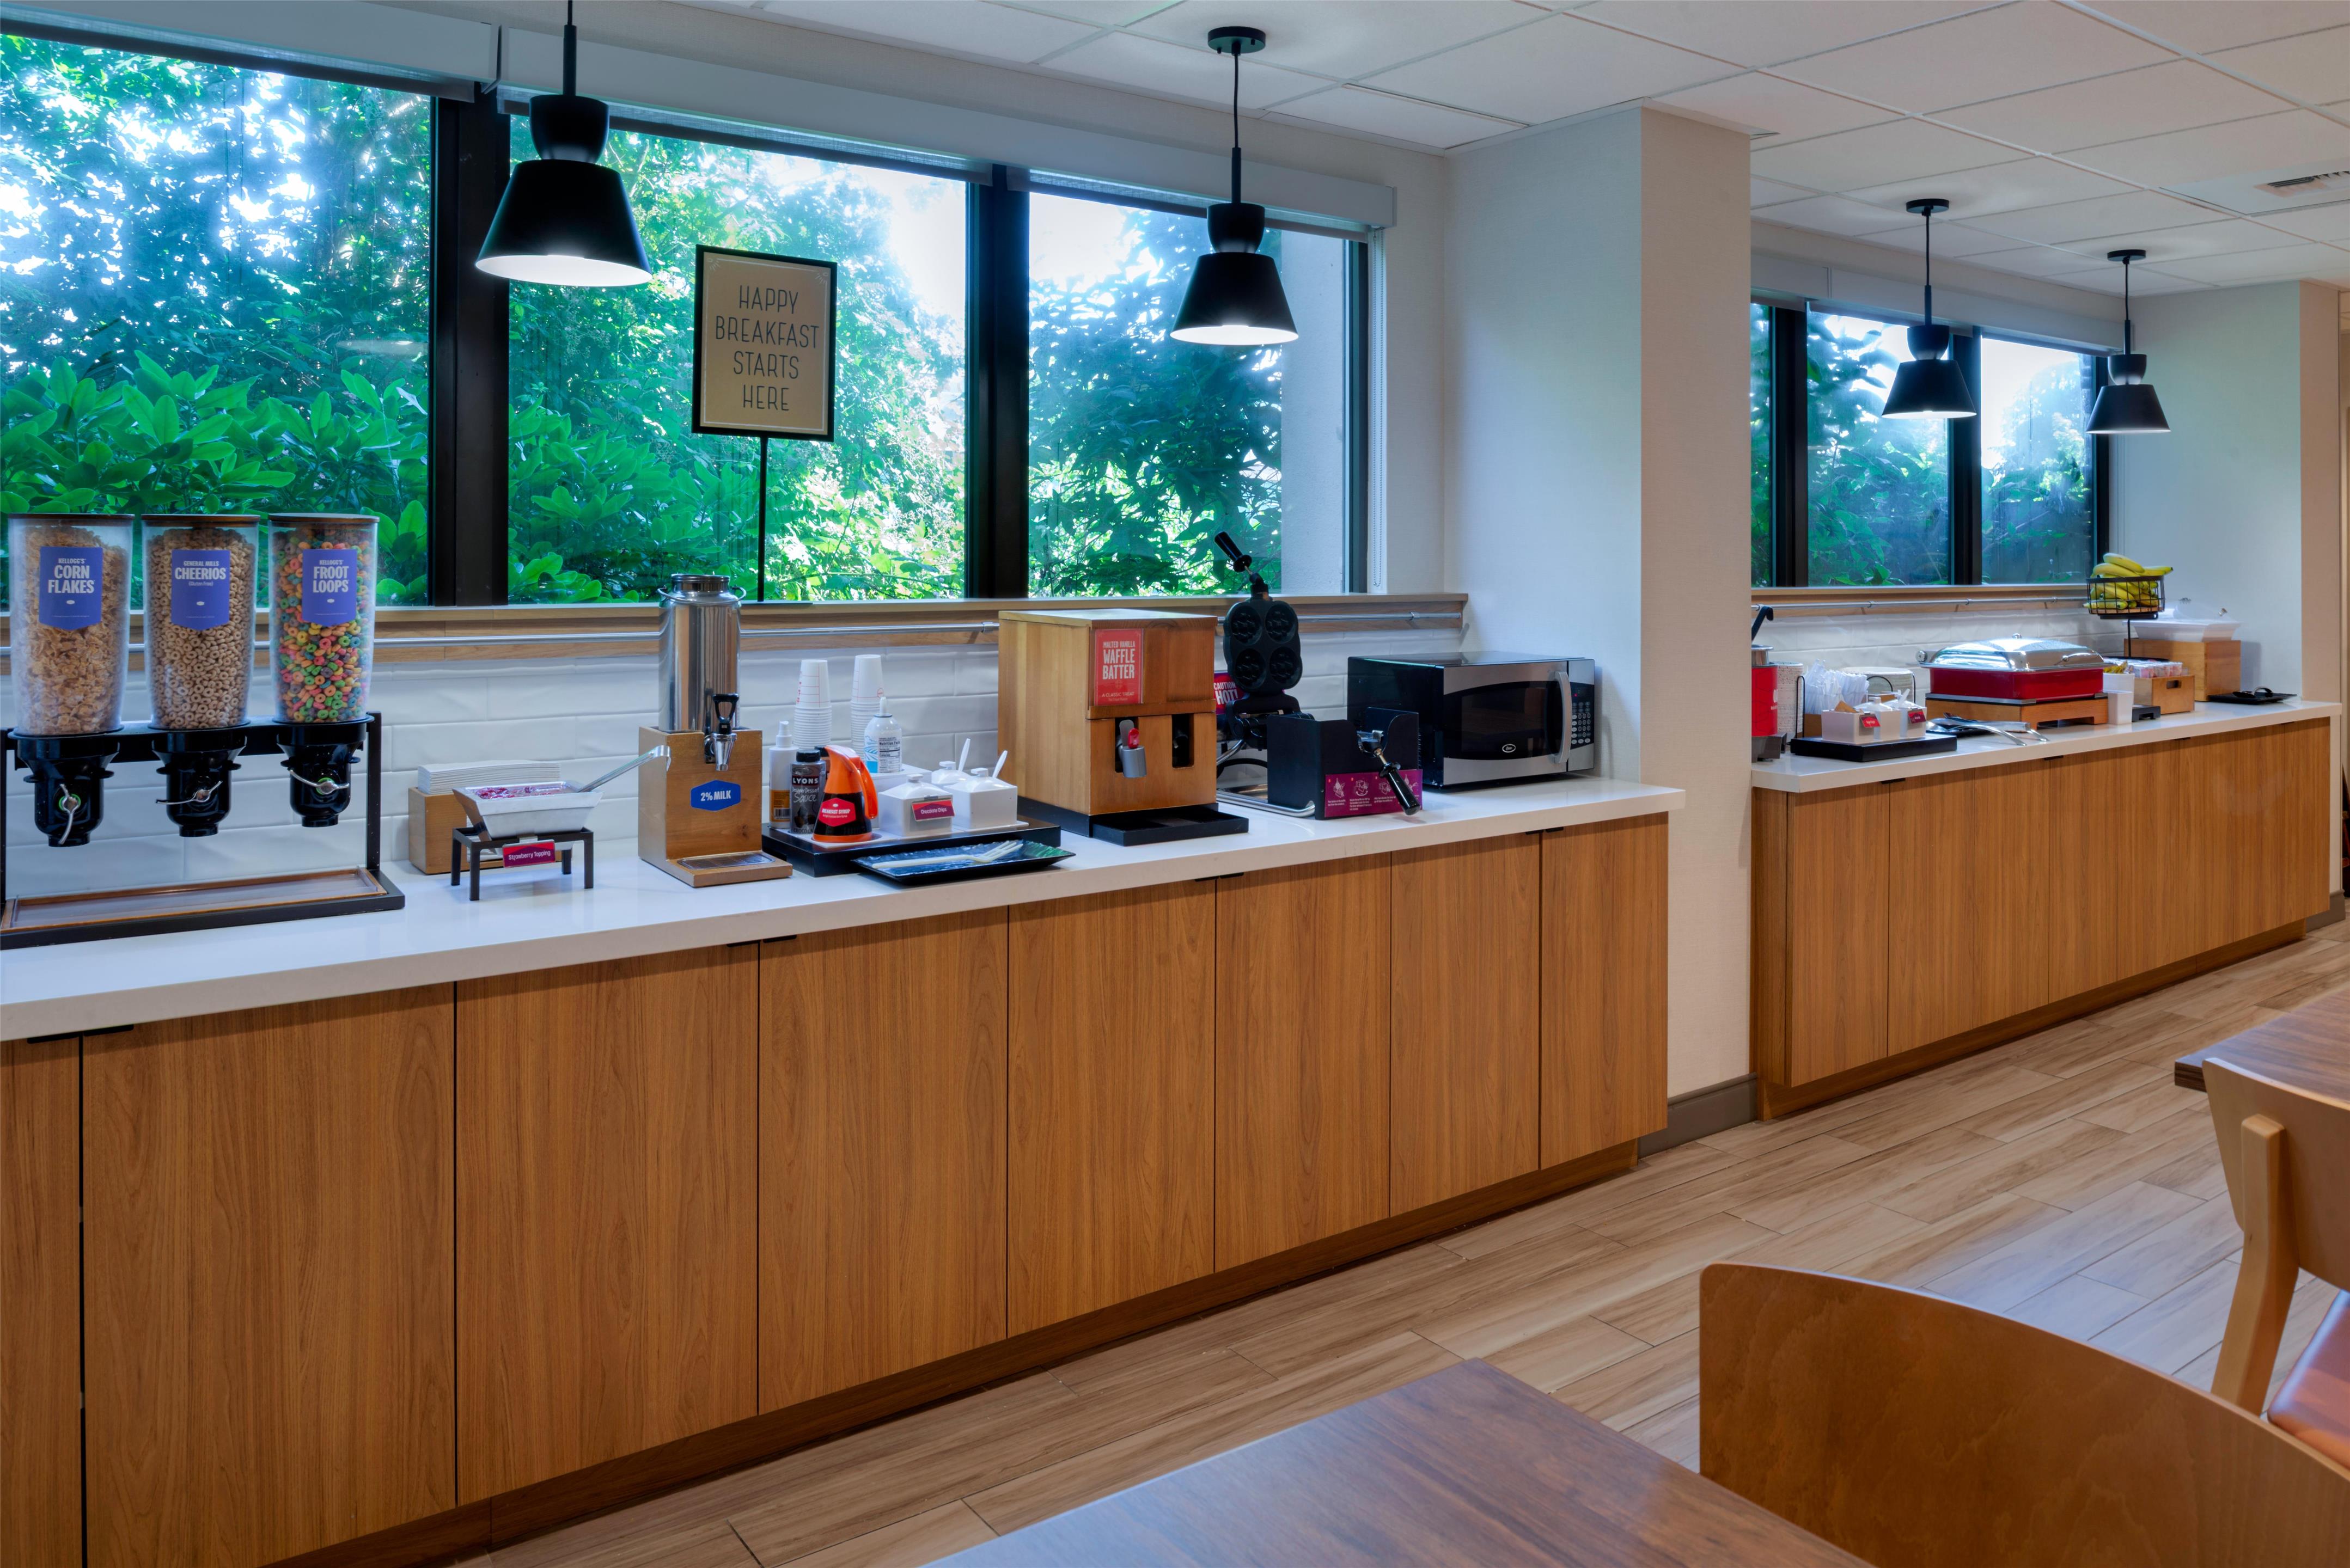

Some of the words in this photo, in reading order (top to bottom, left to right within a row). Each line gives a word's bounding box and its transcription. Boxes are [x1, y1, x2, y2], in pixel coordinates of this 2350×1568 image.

[739, 285, 798, 314] HAPPY
[715, 315, 820, 348] BREAKFAST
[733, 351, 799, 379] STARTS
[743, 384, 789, 411] HERE
[54, 565, 90, 579] CORN
[175, 567, 227, 580] CHEERIOS
[313, 566, 349, 579] FROOT
[48, 580, 95, 593] FLAKES
[313, 580, 349, 593] LOOPS
[1103, 649, 1136, 664] WAFFLE
[1102, 664, 1135, 680] BATTER
[1213, 682, 1236, 690] CAUTION
[1215, 689, 1238, 705] HOT!
[700, 792, 713, 801] 2%
[713, 790, 731, 800] MILK
[793, 793, 817, 803] Sauce
[508, 853, 533, 861] Strawberry
